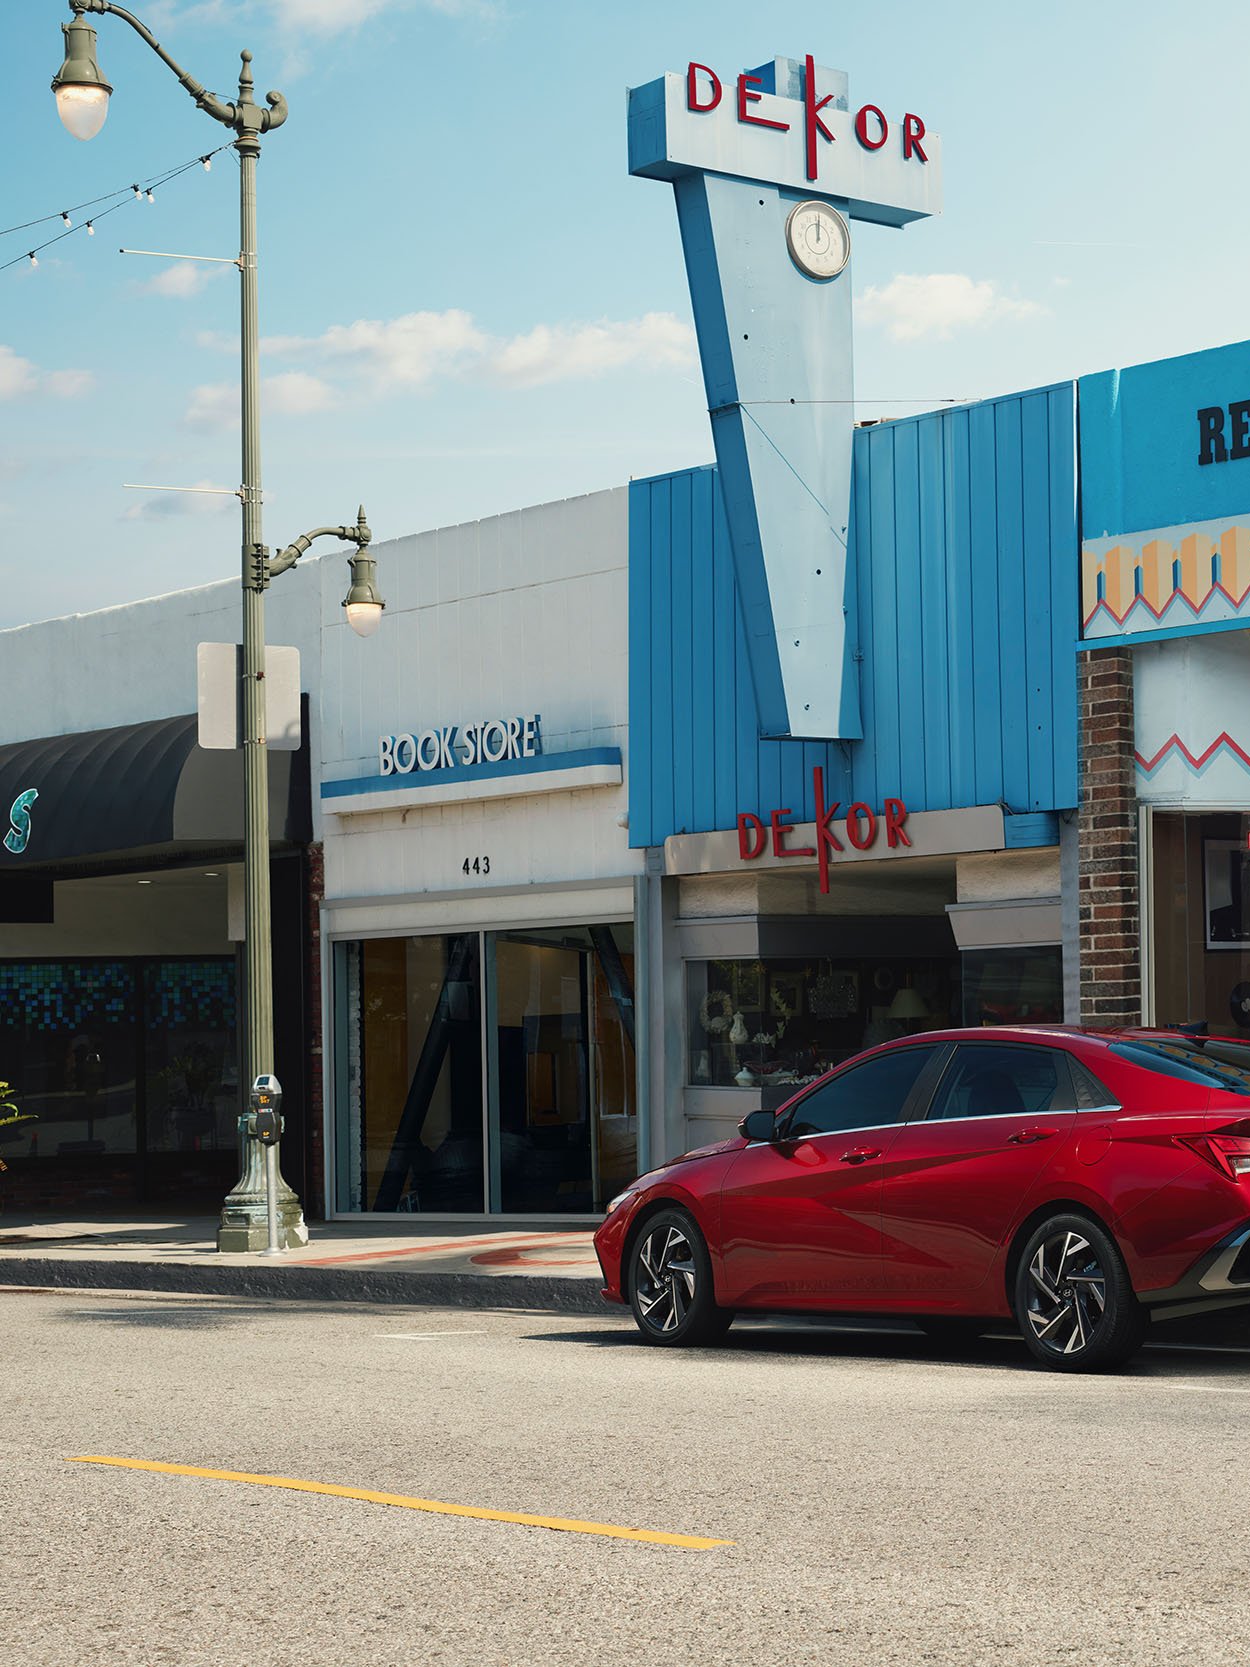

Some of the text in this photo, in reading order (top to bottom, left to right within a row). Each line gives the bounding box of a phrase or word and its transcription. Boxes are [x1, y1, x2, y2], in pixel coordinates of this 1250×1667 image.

[687, 54, 929, 180] DEKOR
[378, 715, 540, 776] BOOK STORE
[462, 856, 490, 875] 443
[737, 766, 911, 893] DEKOR
